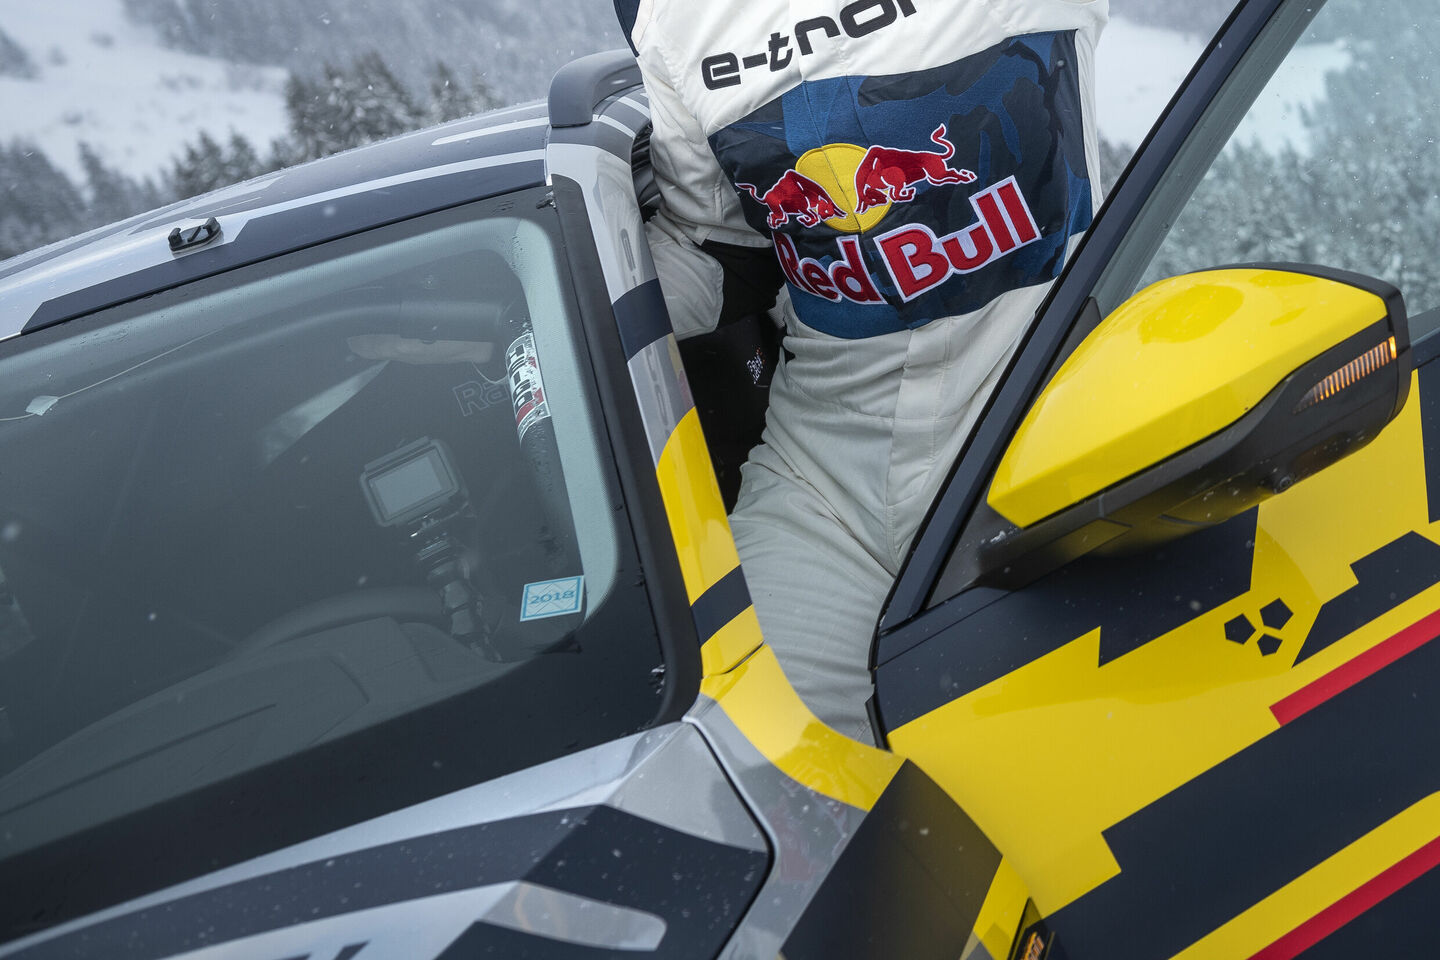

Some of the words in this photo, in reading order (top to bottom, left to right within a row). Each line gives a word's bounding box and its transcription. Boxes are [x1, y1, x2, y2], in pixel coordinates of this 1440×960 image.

[771, 230, 889, 305] Red
[873, 174, 1042, 303] Bull
[529, 590, 576, 605] 2018
